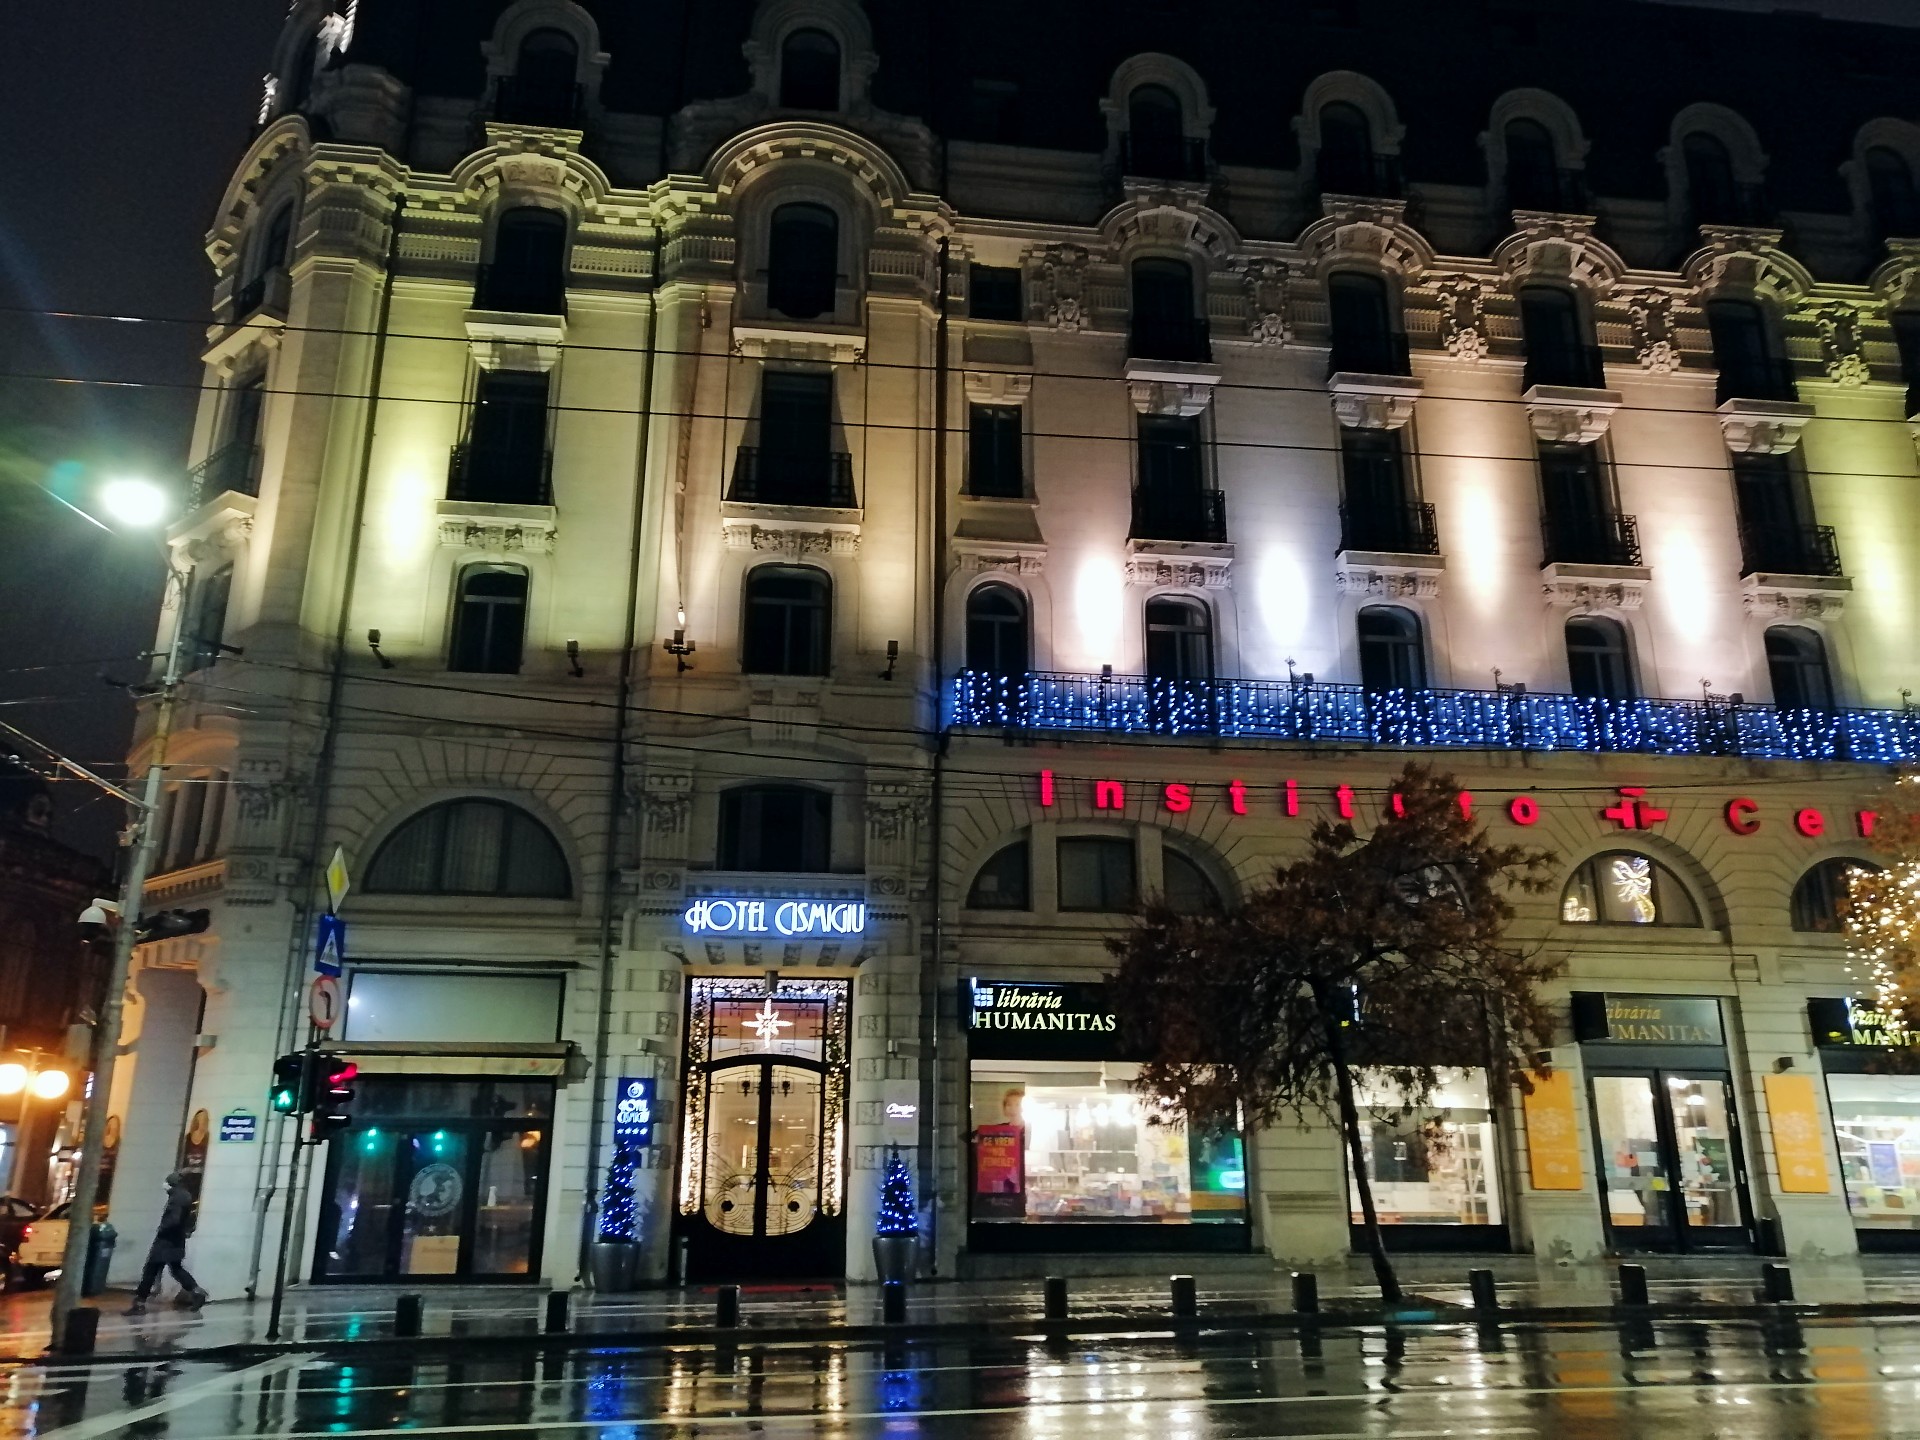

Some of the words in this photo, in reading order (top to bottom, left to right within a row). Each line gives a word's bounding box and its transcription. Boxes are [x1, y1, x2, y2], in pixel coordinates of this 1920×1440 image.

[1725, 797, 1878, 837] Cer
[684, 900, 768, 933] HOTEL
[774, 901, 865, 935] CISMIGIU
[997, 987, 1063, 1009] librăria
[1606, 1001, 1661, 1020] ibrăria
[975, 1011, 1117, 1032] HUMANITAS
[1609, 1024, 1712, 1041] MANITAS
